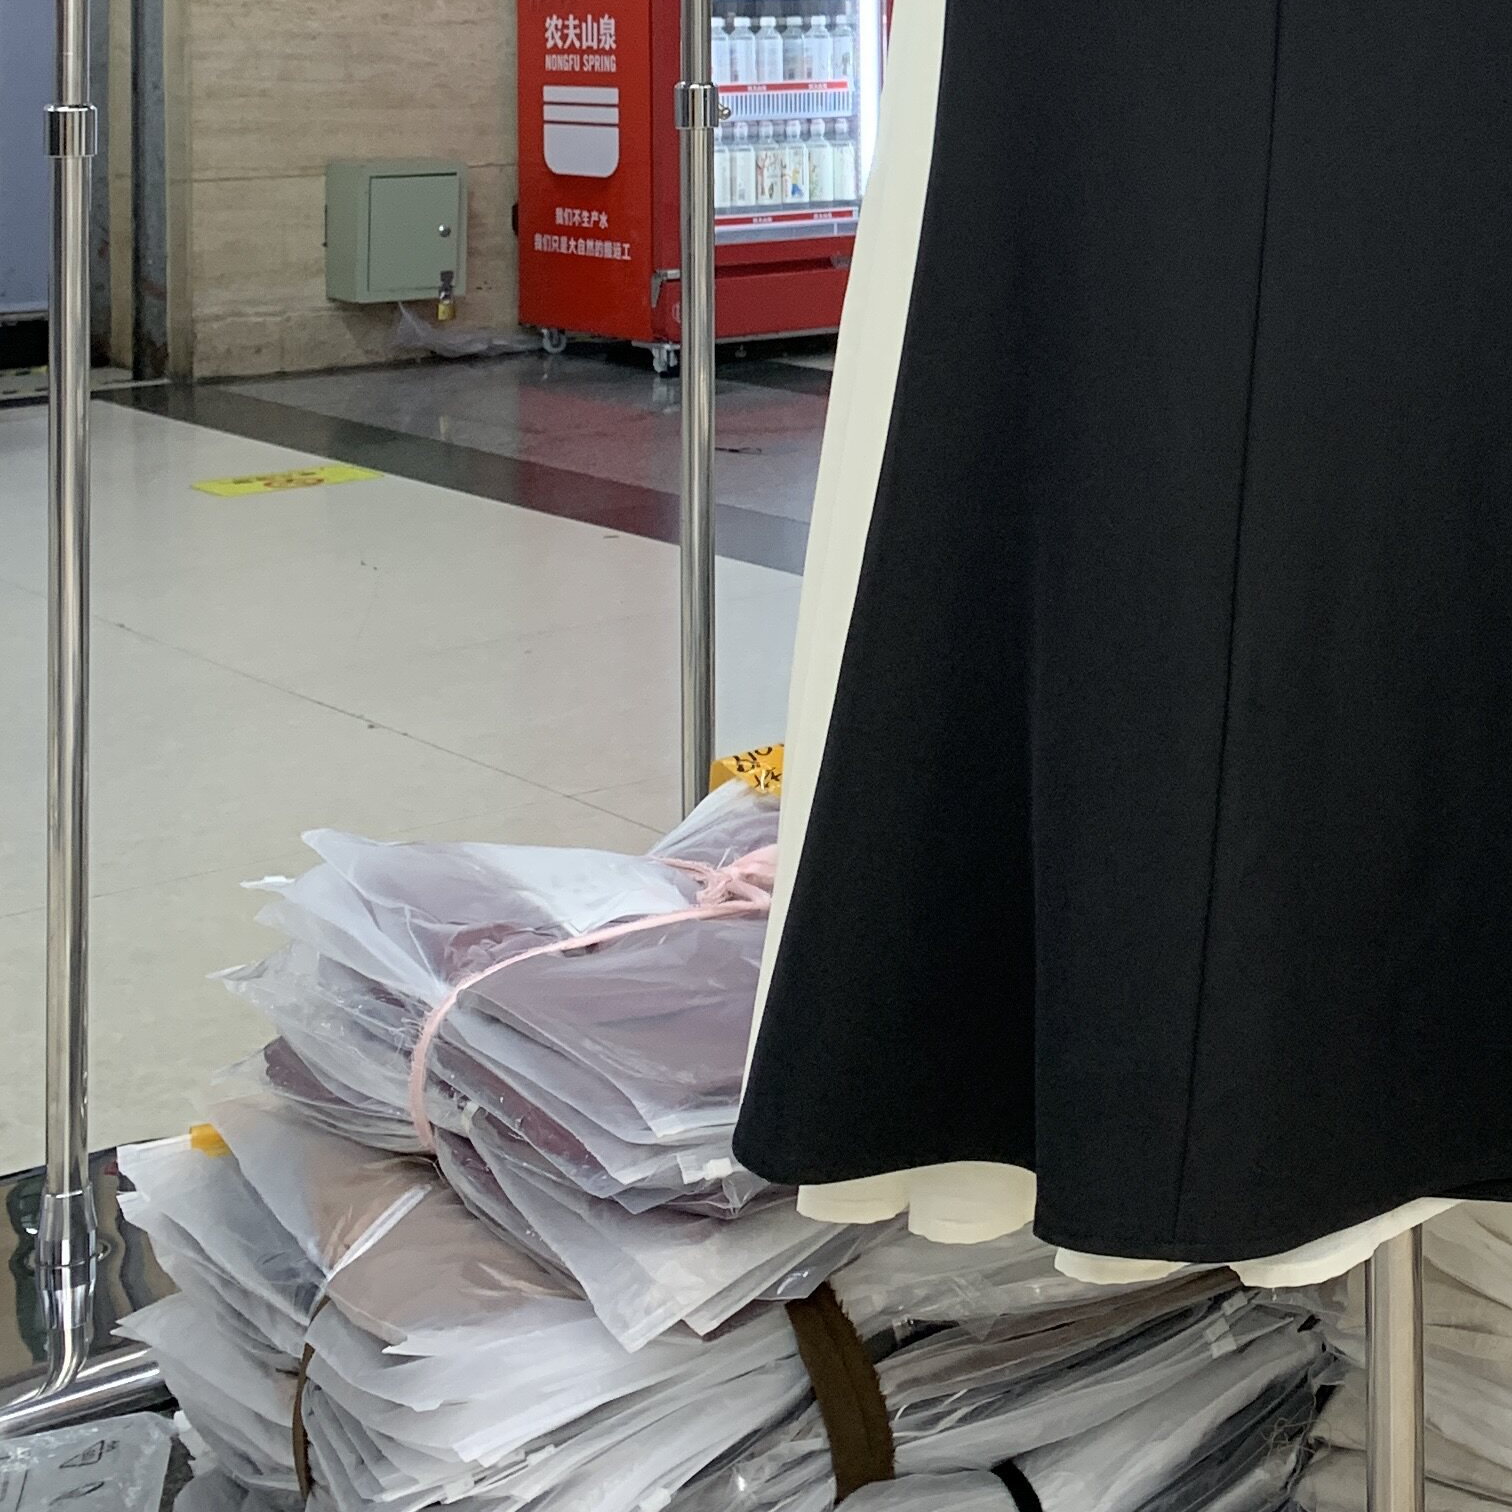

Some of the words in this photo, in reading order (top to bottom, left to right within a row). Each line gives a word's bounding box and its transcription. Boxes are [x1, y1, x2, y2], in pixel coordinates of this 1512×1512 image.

[544, 13, 617, 51] 农夫山泉
[544, 53, 580, 72] NONGFU
[582, 54, 617, 73] SPRING
[555, 206, 609, 229] 我们不生产水
